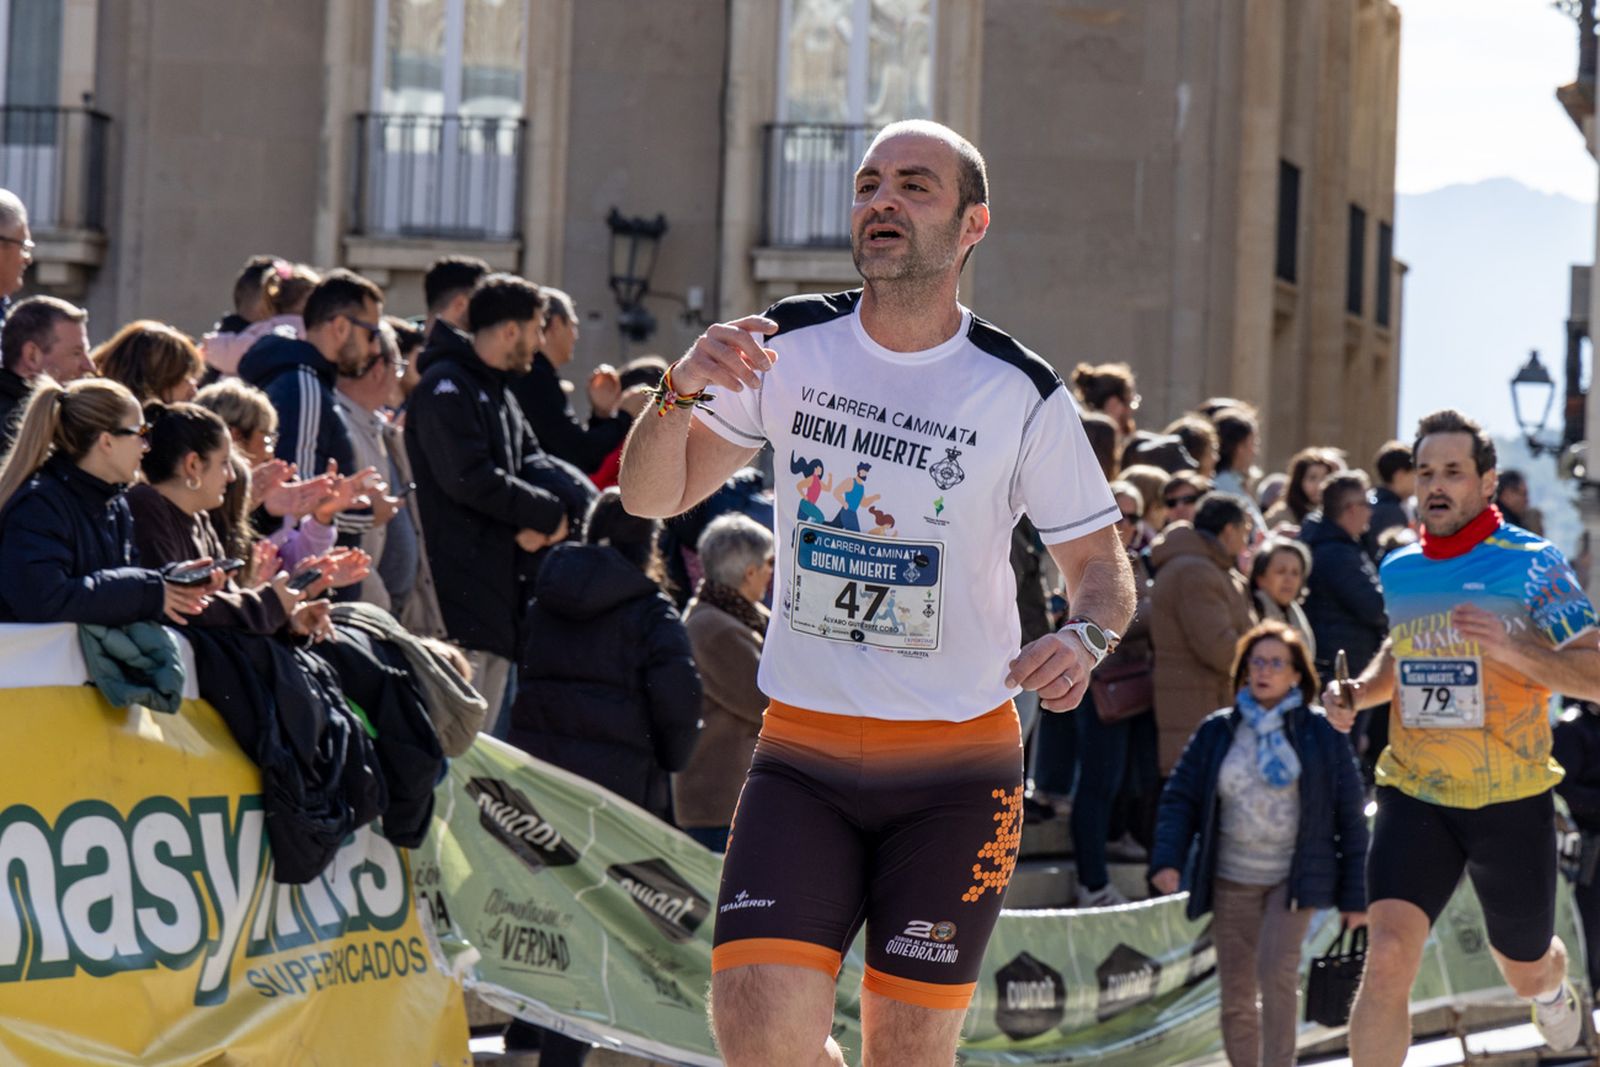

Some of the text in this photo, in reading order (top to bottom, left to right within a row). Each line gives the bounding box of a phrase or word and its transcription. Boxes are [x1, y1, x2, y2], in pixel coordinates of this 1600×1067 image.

[802, 386, 978, 447] VI CARRERA CAMINATA
[791, 411, 932, 470] BUENA MUERTE
[824, 538, 866, 555] CARRERA
[811, 551, 897, 580] BUENA MUERTE
[835, 581, 890, 621] 47
[1421, 687, 1451, 711] 79
[720, 899, 776, 914] TEAMERGY
[502, 922, 570, 972] VERDAD
[885, 940, 959, 964] QUIEBRAJANO
